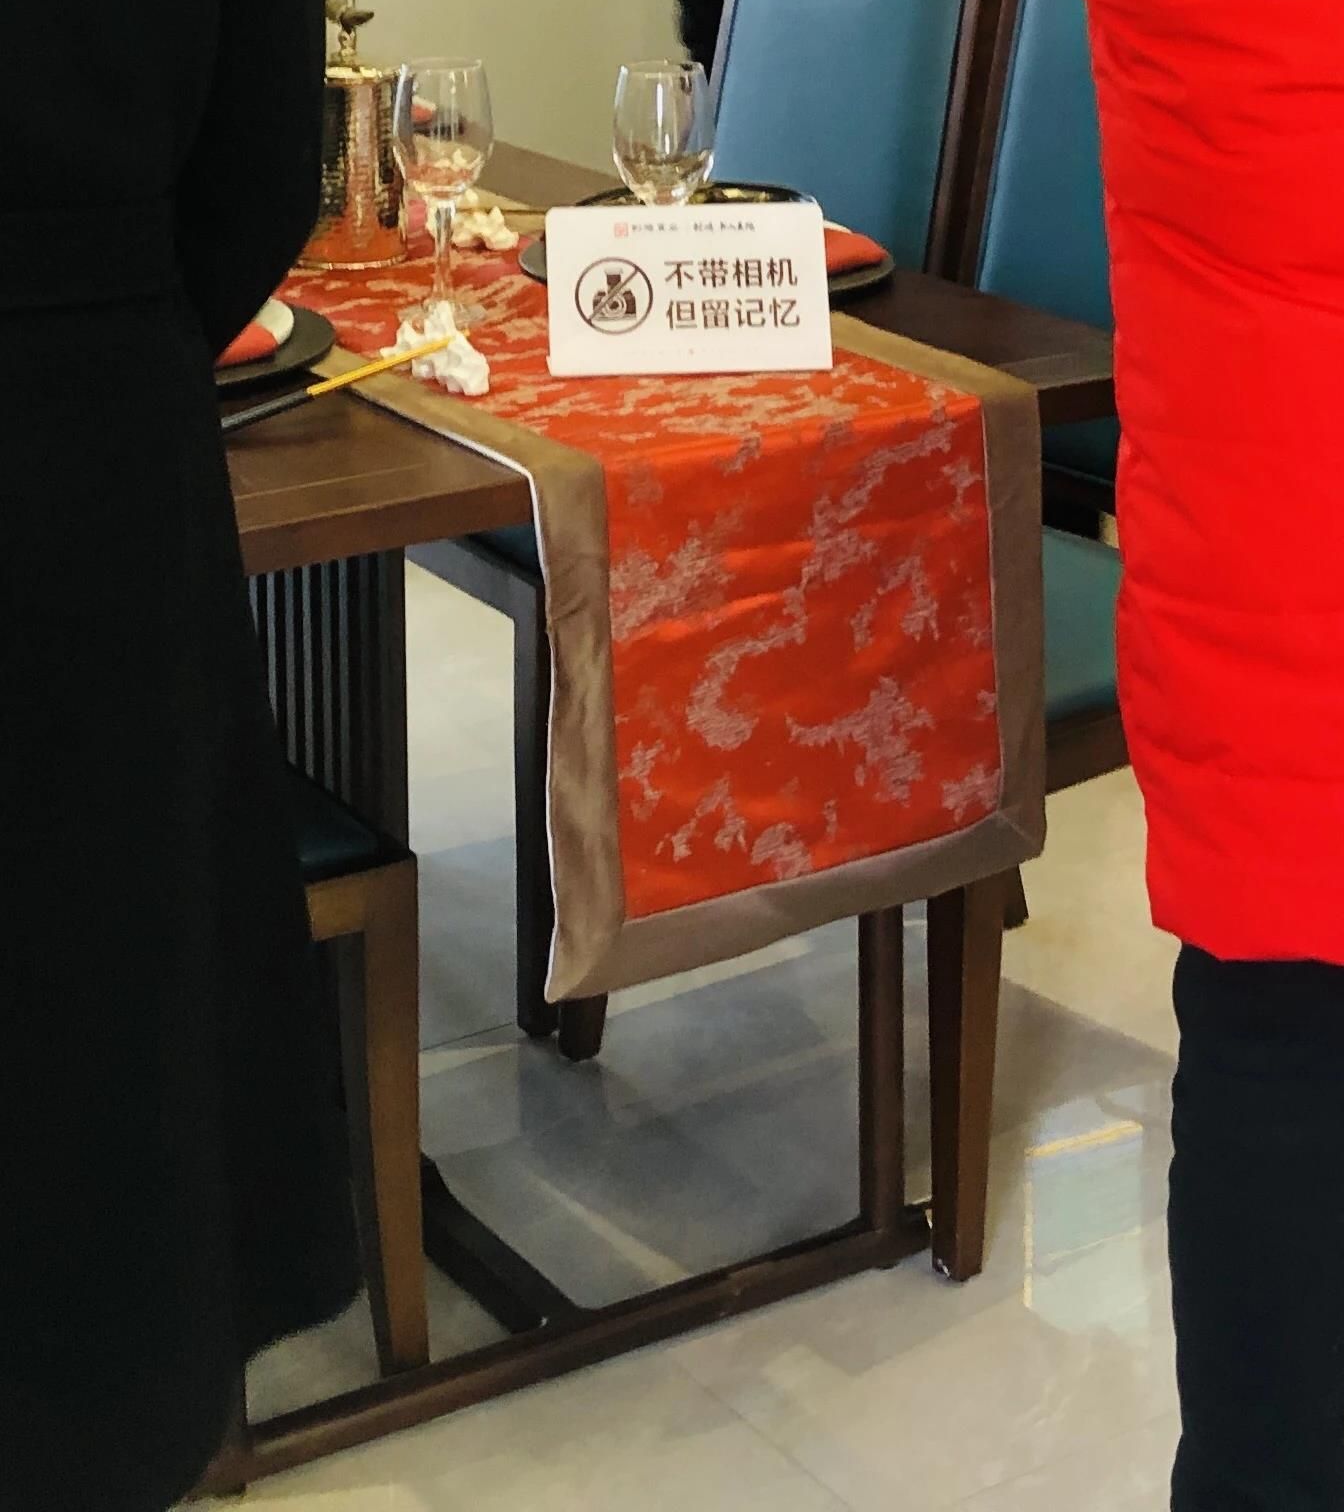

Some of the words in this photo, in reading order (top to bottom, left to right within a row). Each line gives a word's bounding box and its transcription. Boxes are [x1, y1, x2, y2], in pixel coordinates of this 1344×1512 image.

[664, 257, 798, 289] 不带相机
[666, 297, 800, 330] 但留记忆
